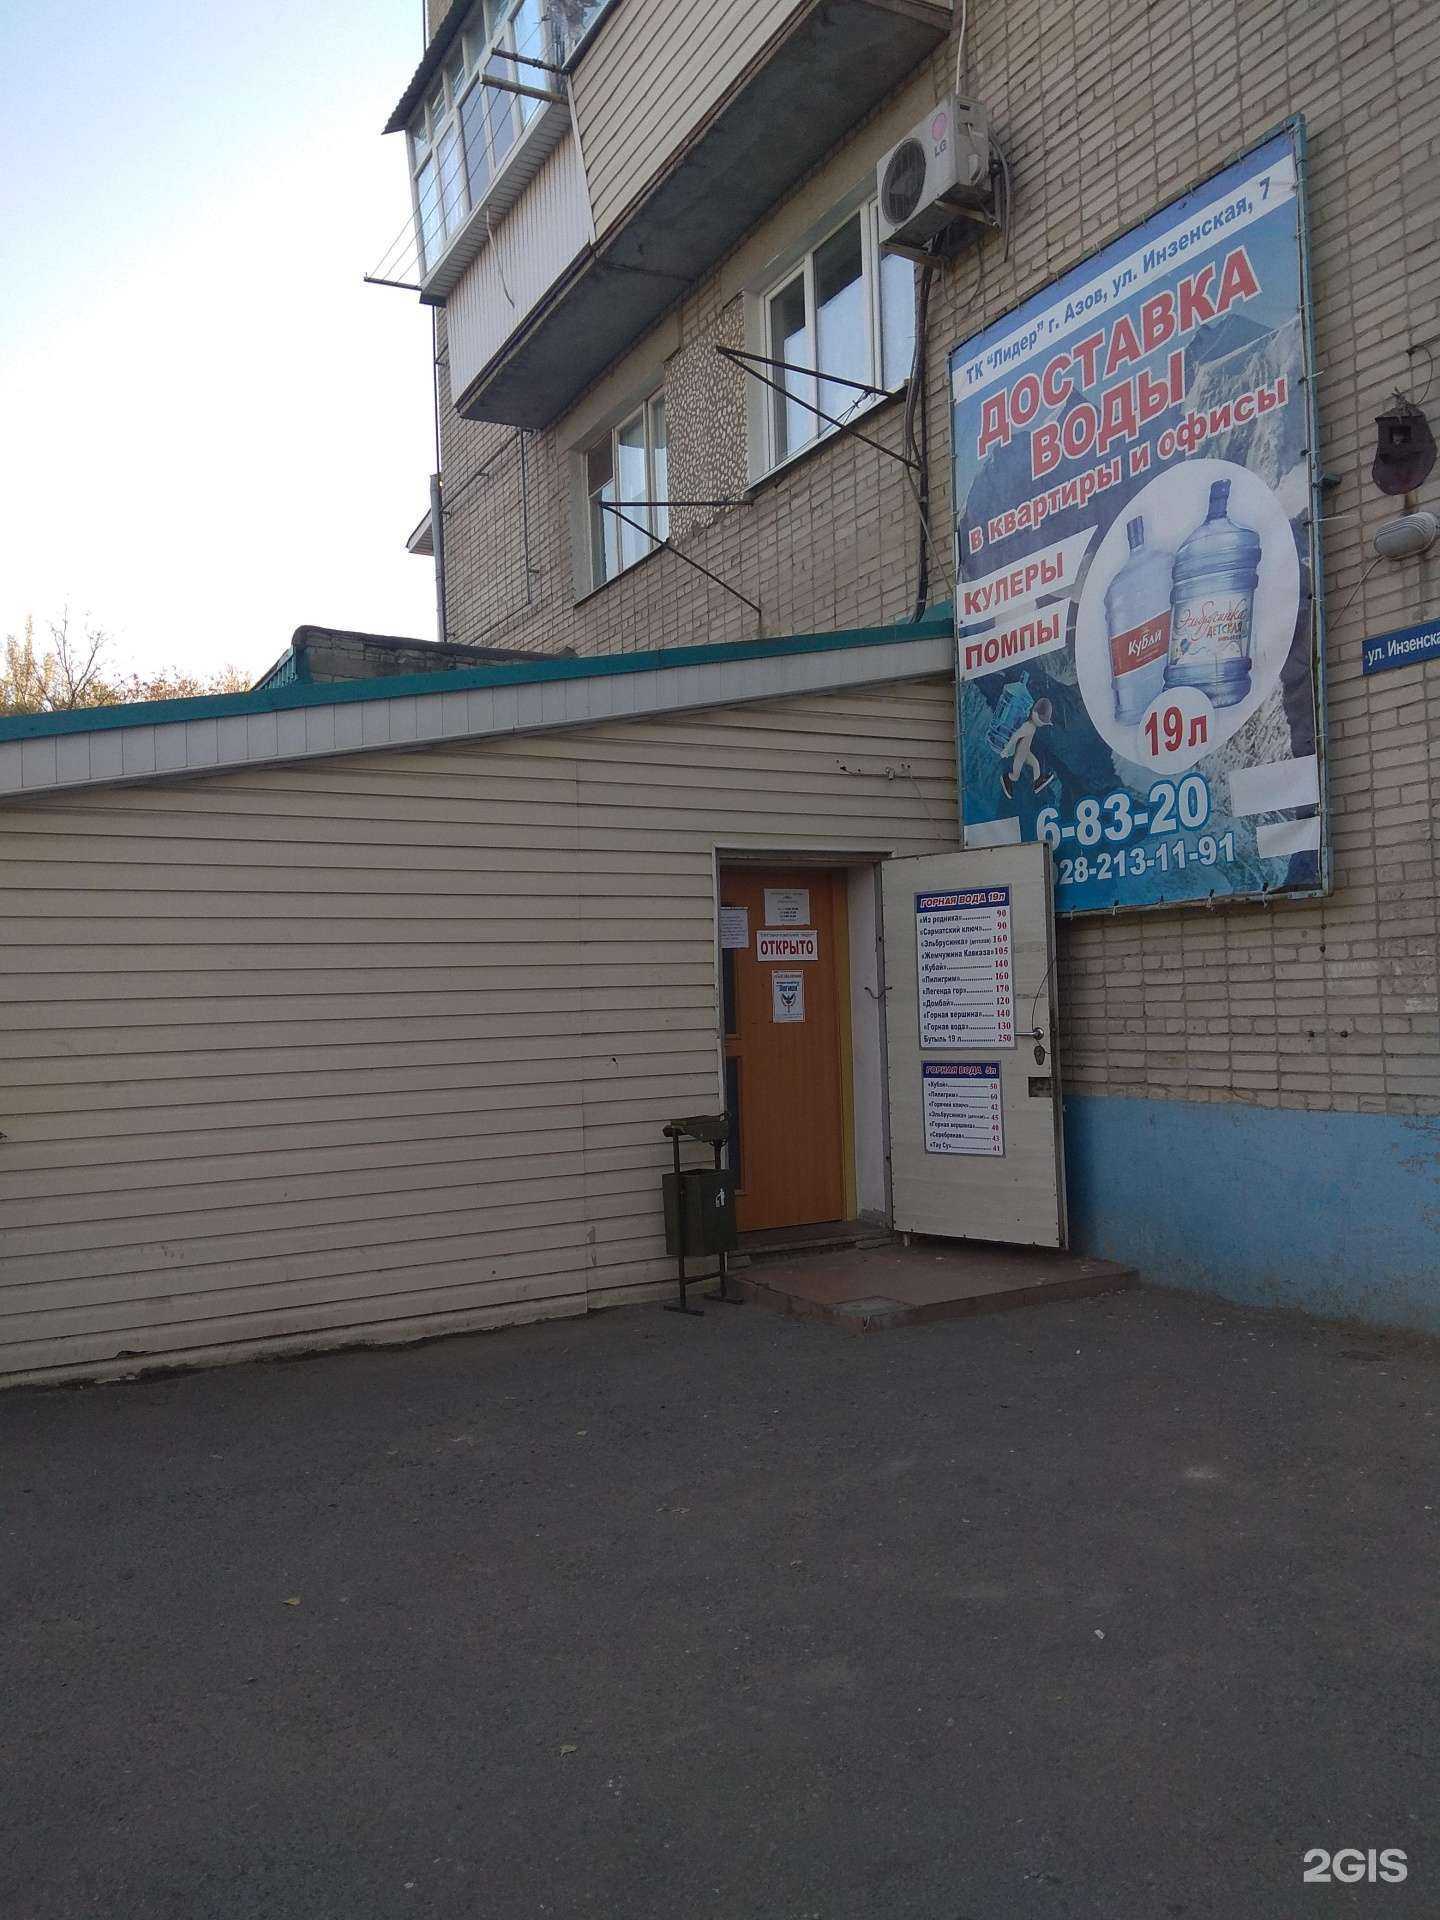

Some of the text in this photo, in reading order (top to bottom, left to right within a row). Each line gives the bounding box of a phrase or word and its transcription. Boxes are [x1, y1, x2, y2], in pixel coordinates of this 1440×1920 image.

[934, 140, 947, 158] LG
[967, 360, 984, 385] ТК
[1048, 316, 1059, 333] г.
[1065, 289, 1108, 324] Азов,
[1112, 271, 1137, 298] ул.
[1143, 196, 1253, 273] Инзенская,
[1259, 176, 1271, 200] 7
[977, 247, 1262, 458] ДОСТАВКА
[1031, 350, 1187, 480] ВОДЫ
[968, 376, 1287, 554] в квартиры и офисы
[964, 552, 1063, 615] КУЛЕРЫ
[965, 613, 1059, 670] ПОМПЫ
[1368, 648, 1385, 666] ул.
[1036, 776, 1208, 851] 6-83-20
[1058, 832, 1235, 884] 28-213-11-91
[920, 896, 957, 908] ГОРНАЯ
[958, 893, 986, 905] ВОДА
[997, 910, 1006, 918] 90
[997, 922, 1007, 930] 90
[993, 935, 1008, 943] 160
[760, 940, 813, 955] ОТКРЫТО
[995, 960, 1008, 968] 140
[995, 972, 1009, 980] 160
[996, 997, 1010, 1005] 120
[998, 1022, 1011, 1030] 130
[998, 1034, 1012, 1042] 250
